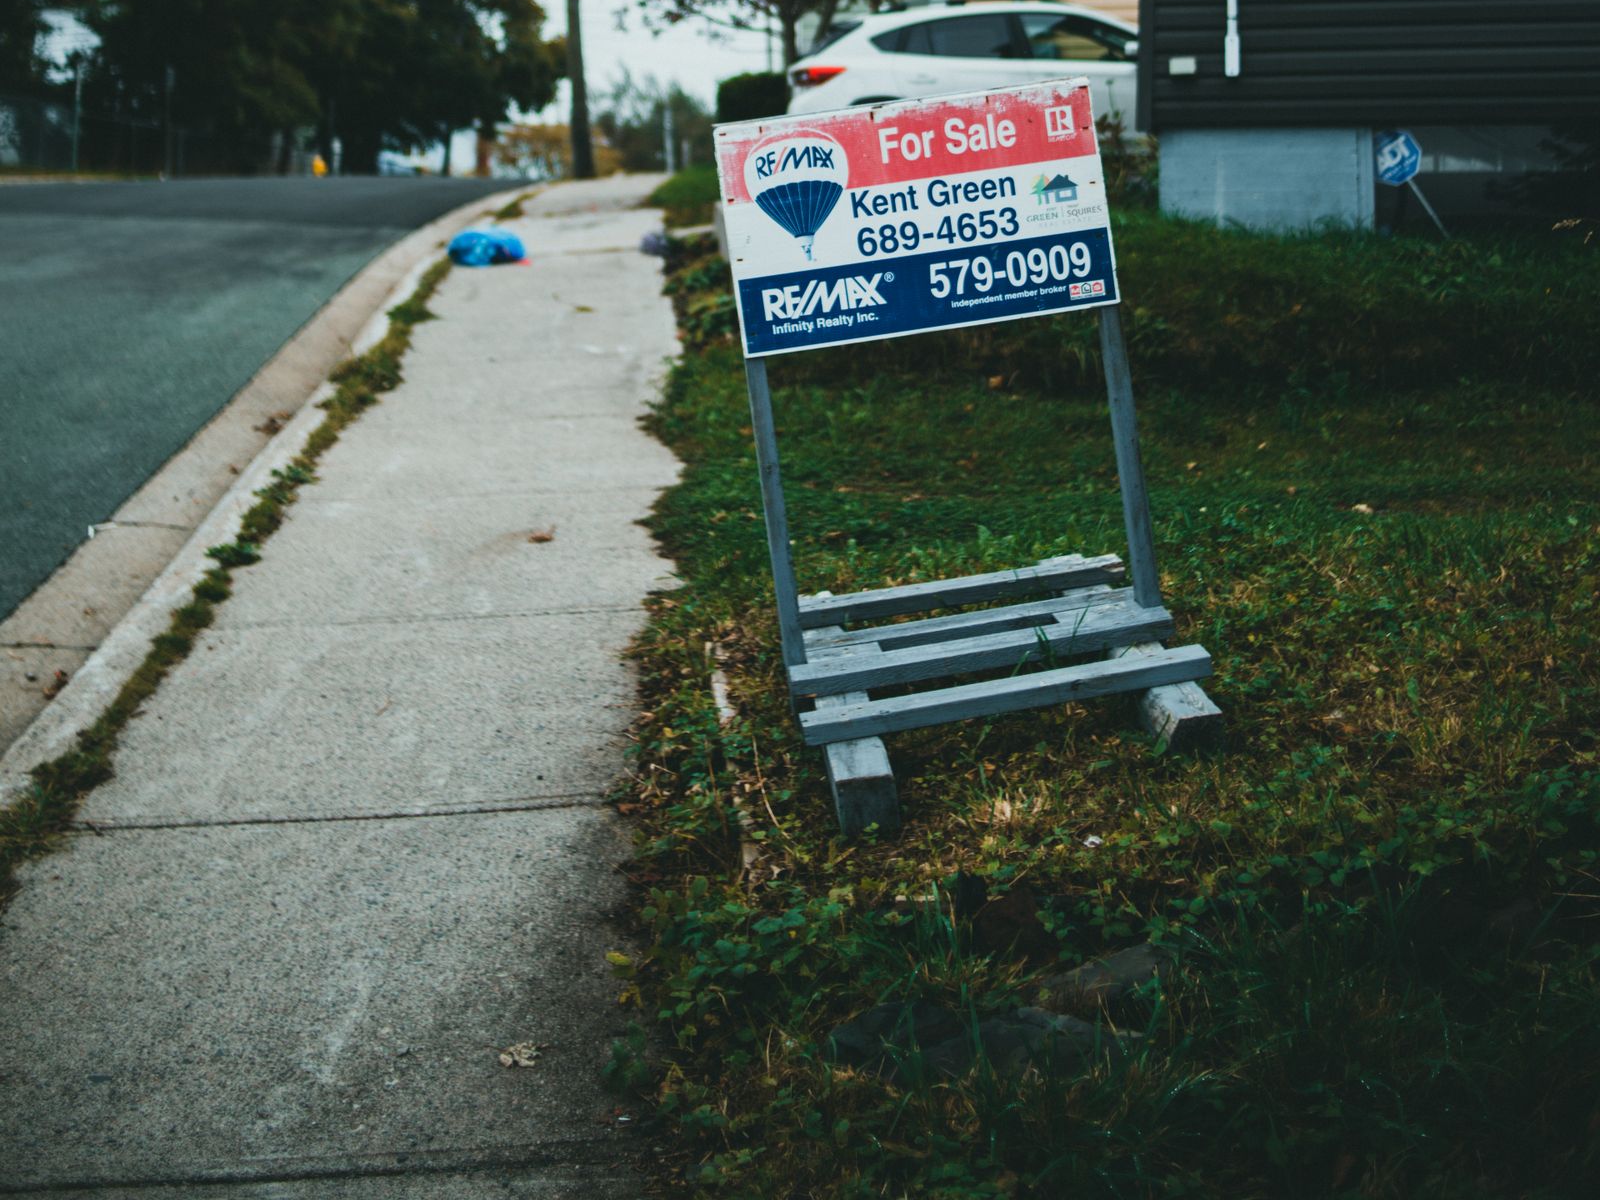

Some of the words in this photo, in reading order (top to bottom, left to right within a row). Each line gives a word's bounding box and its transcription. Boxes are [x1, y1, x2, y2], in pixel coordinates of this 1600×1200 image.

[878, 126, 935, 164] For
[944, 113, 1017, 155] Sale
[755, 145, 834, 180] RE/MAX
[850, 185, 919, 218] Kent
[927, 176, 1017, 207] Green
[1066, 205, 1102, 217] SQUIRES
[857, 206, 1020, 257] 689-4653
[1026, 212, 1059, 223] GREEN
[929, 241, 1092, 299] 579-0909
[1004, 289, 1038, 301] member
[1039, 284, 1067, 296] broker
[772, 320, 814, 335] Infinity
[816, 314, 854, 329] Realty
[856, 312, 879, 323] Inc.
